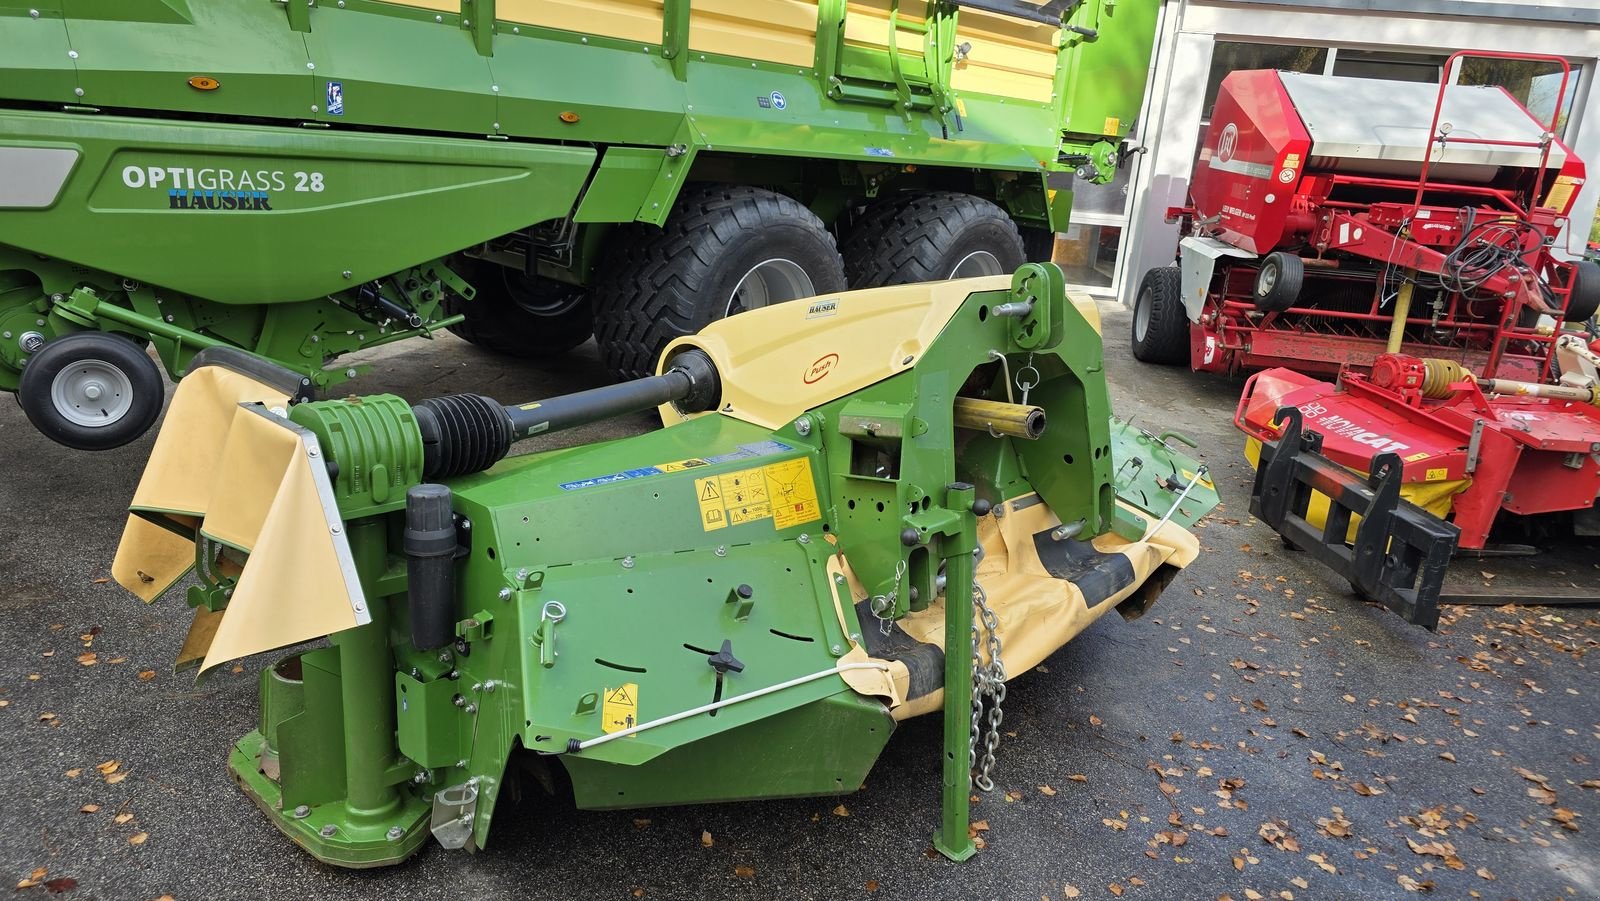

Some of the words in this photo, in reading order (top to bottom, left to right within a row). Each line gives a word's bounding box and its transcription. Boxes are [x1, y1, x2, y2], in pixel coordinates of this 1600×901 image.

[122, 165, 286, 191] OPTIGRASS
[294, 171, 325, 193] 28
[168, 189, 272, 211] HAUSER
[809, 302, 836, 313] HAUSER
[810, 360, 831, 377] Push
[1316, 415, 1411, 452] NOVACAT
